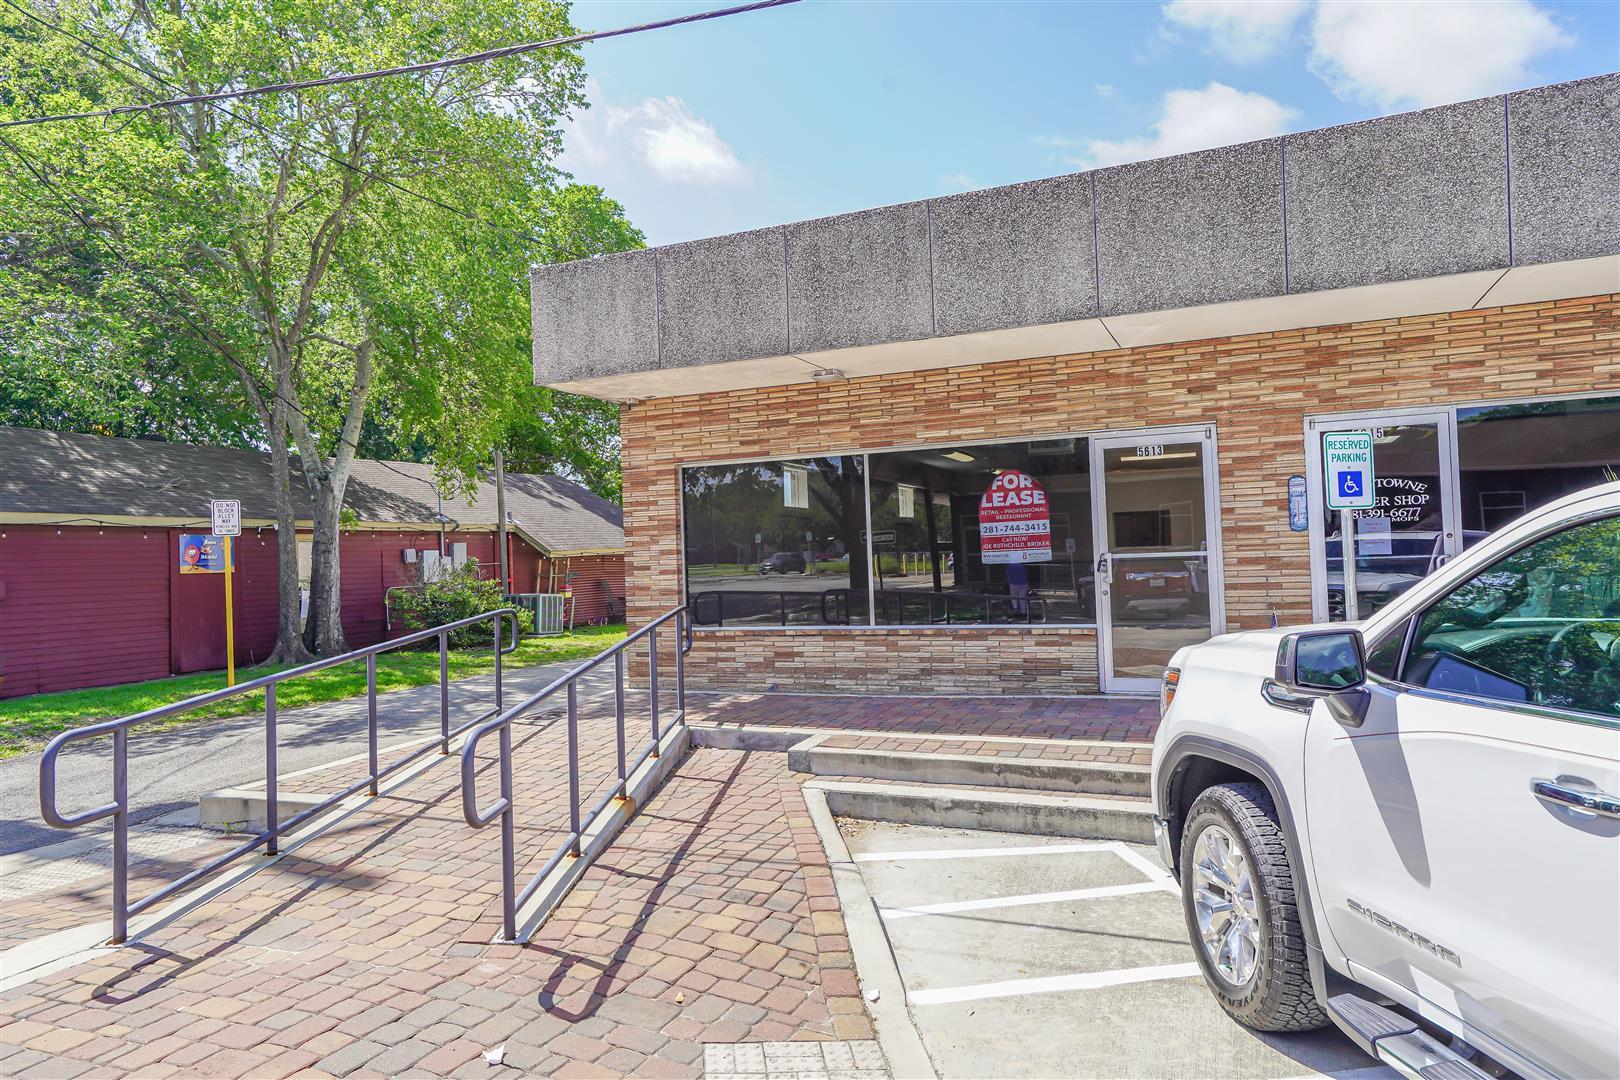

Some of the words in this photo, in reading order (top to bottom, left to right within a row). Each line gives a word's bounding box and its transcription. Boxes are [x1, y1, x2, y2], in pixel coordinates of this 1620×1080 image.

[1328, 440, 1369, 450] RESERVED
[1139, 446, 1162, 456] 5613
[1331, 453, 1367, 462] PARKING
[992, 473, 1033, 490] FOR
[981, 490, 1046, 508] LEASE
[1394, 494, 1430, 505] SHOP
[1352, 507, 1421, 519] 81-391-6677
[983, 523, 1047, 534] 281-744-3415
